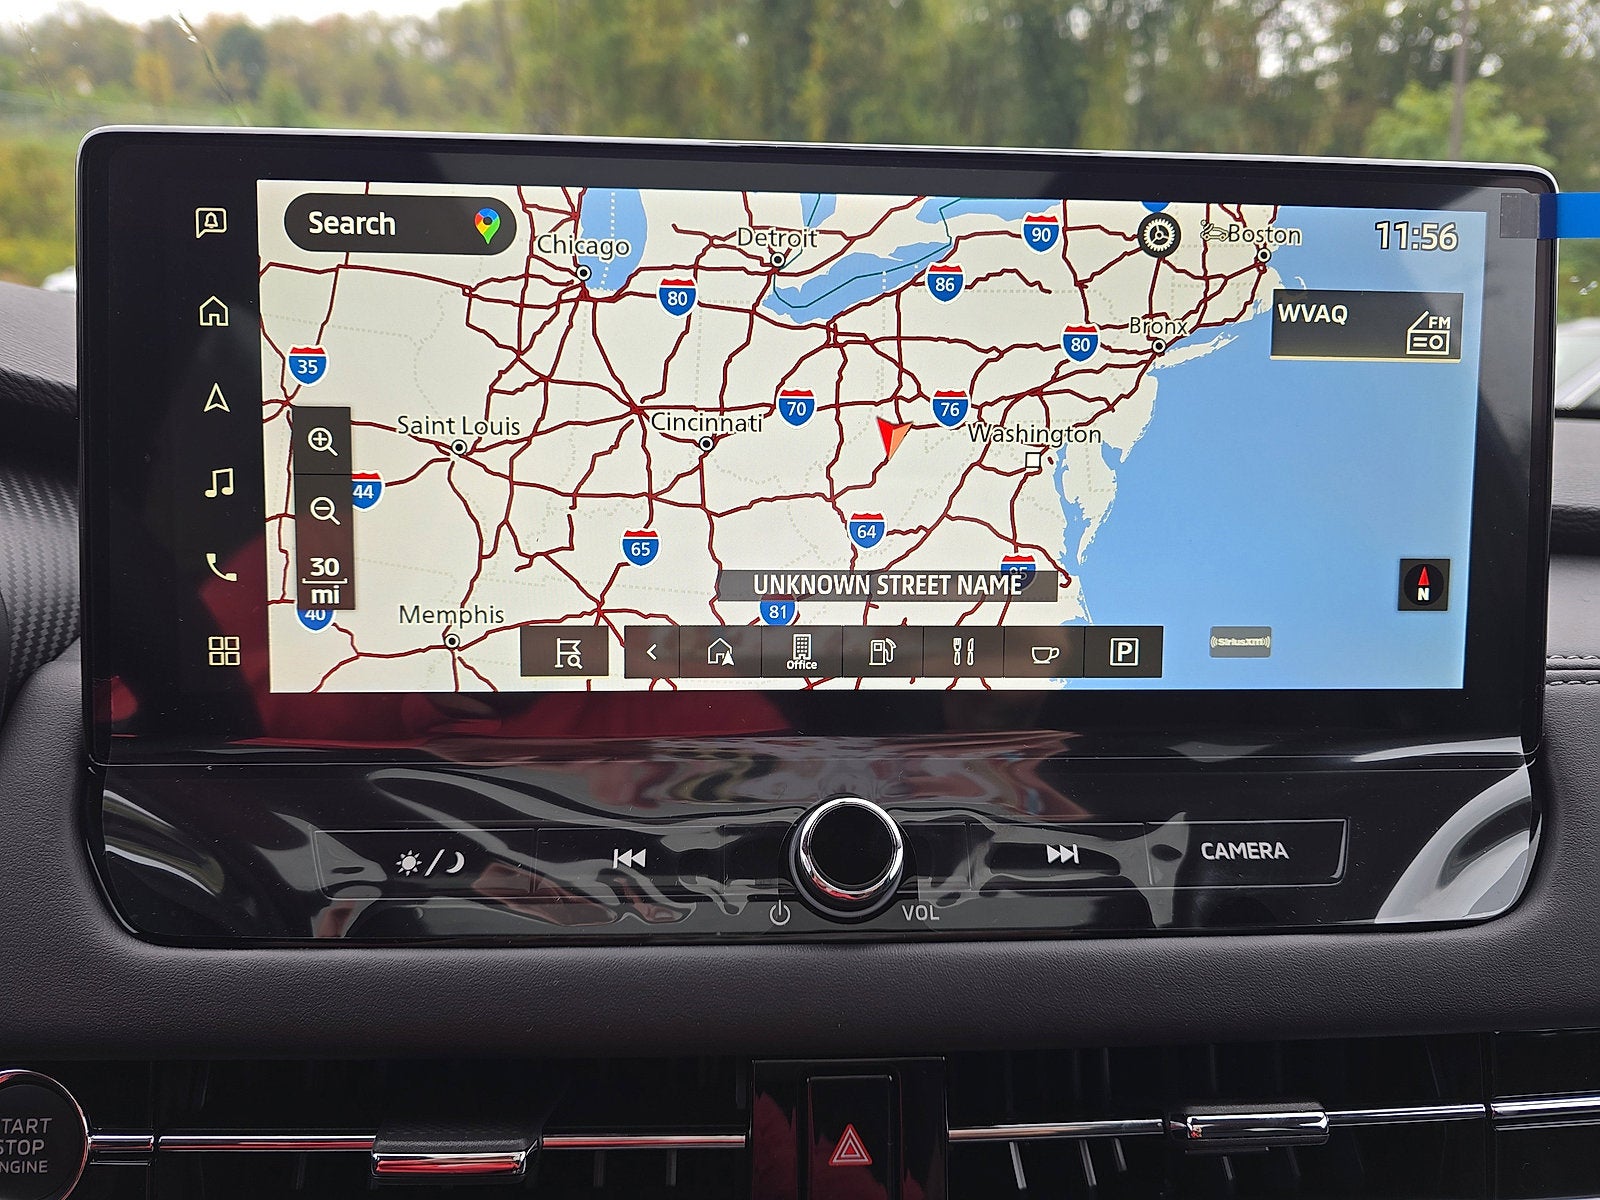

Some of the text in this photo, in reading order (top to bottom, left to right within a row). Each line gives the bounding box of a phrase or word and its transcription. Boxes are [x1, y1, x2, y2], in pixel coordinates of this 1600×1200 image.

[308, 211, 396, 236] Search
[737, 228, 818, 248] Detroit
[1031, 228, 1051, 242] 90
[1229, 224, 1301, 245] Boston
[1375, 220, 1458, 251] 11:56
[537, 234, 630, 259] Chicago
[935, 278, 955, 292] 86
[667, 291, 688, 306] 80
[1278, 304, 1348, 325] WVAQ
[1428, 316, 1451, 329] FM
[1130, 317, 1188, 336] Bronx
[1070, 337, 1091, 352] 80
[297, 360, 318, 374] 35
[786, 402, 807, 416] 70
[940, 402, 961, 417] 76
[398, 416, 520, 436] Saint Louis
[651, 412, 763, 435] Cincinnati
[968, 423, 1102, 448] Washington
[353, 484, 374, 499] 44
[856, 524, 877, 538] 64
[631, 542, 651, 556] 65
[310, 557, 340, 577] 30
[754, 574, 1023, 596] UNKNOWN STREET NAME
[311, 585, 340, 604] mi
[1417, 588, 1430, 600] N
[304, 609, 326, 621] 40
[399, 606, 504, 626] Memphis
[769, 605, 787, 619] 81
[786, 660, 818, 670] Office
[1200, 840, 1290, 862] CAMERA
[901, 904, 940, 922] VOL
[1, 1117, 52, 1134] TART
[0, 1160, 48, 1173] NGINE
